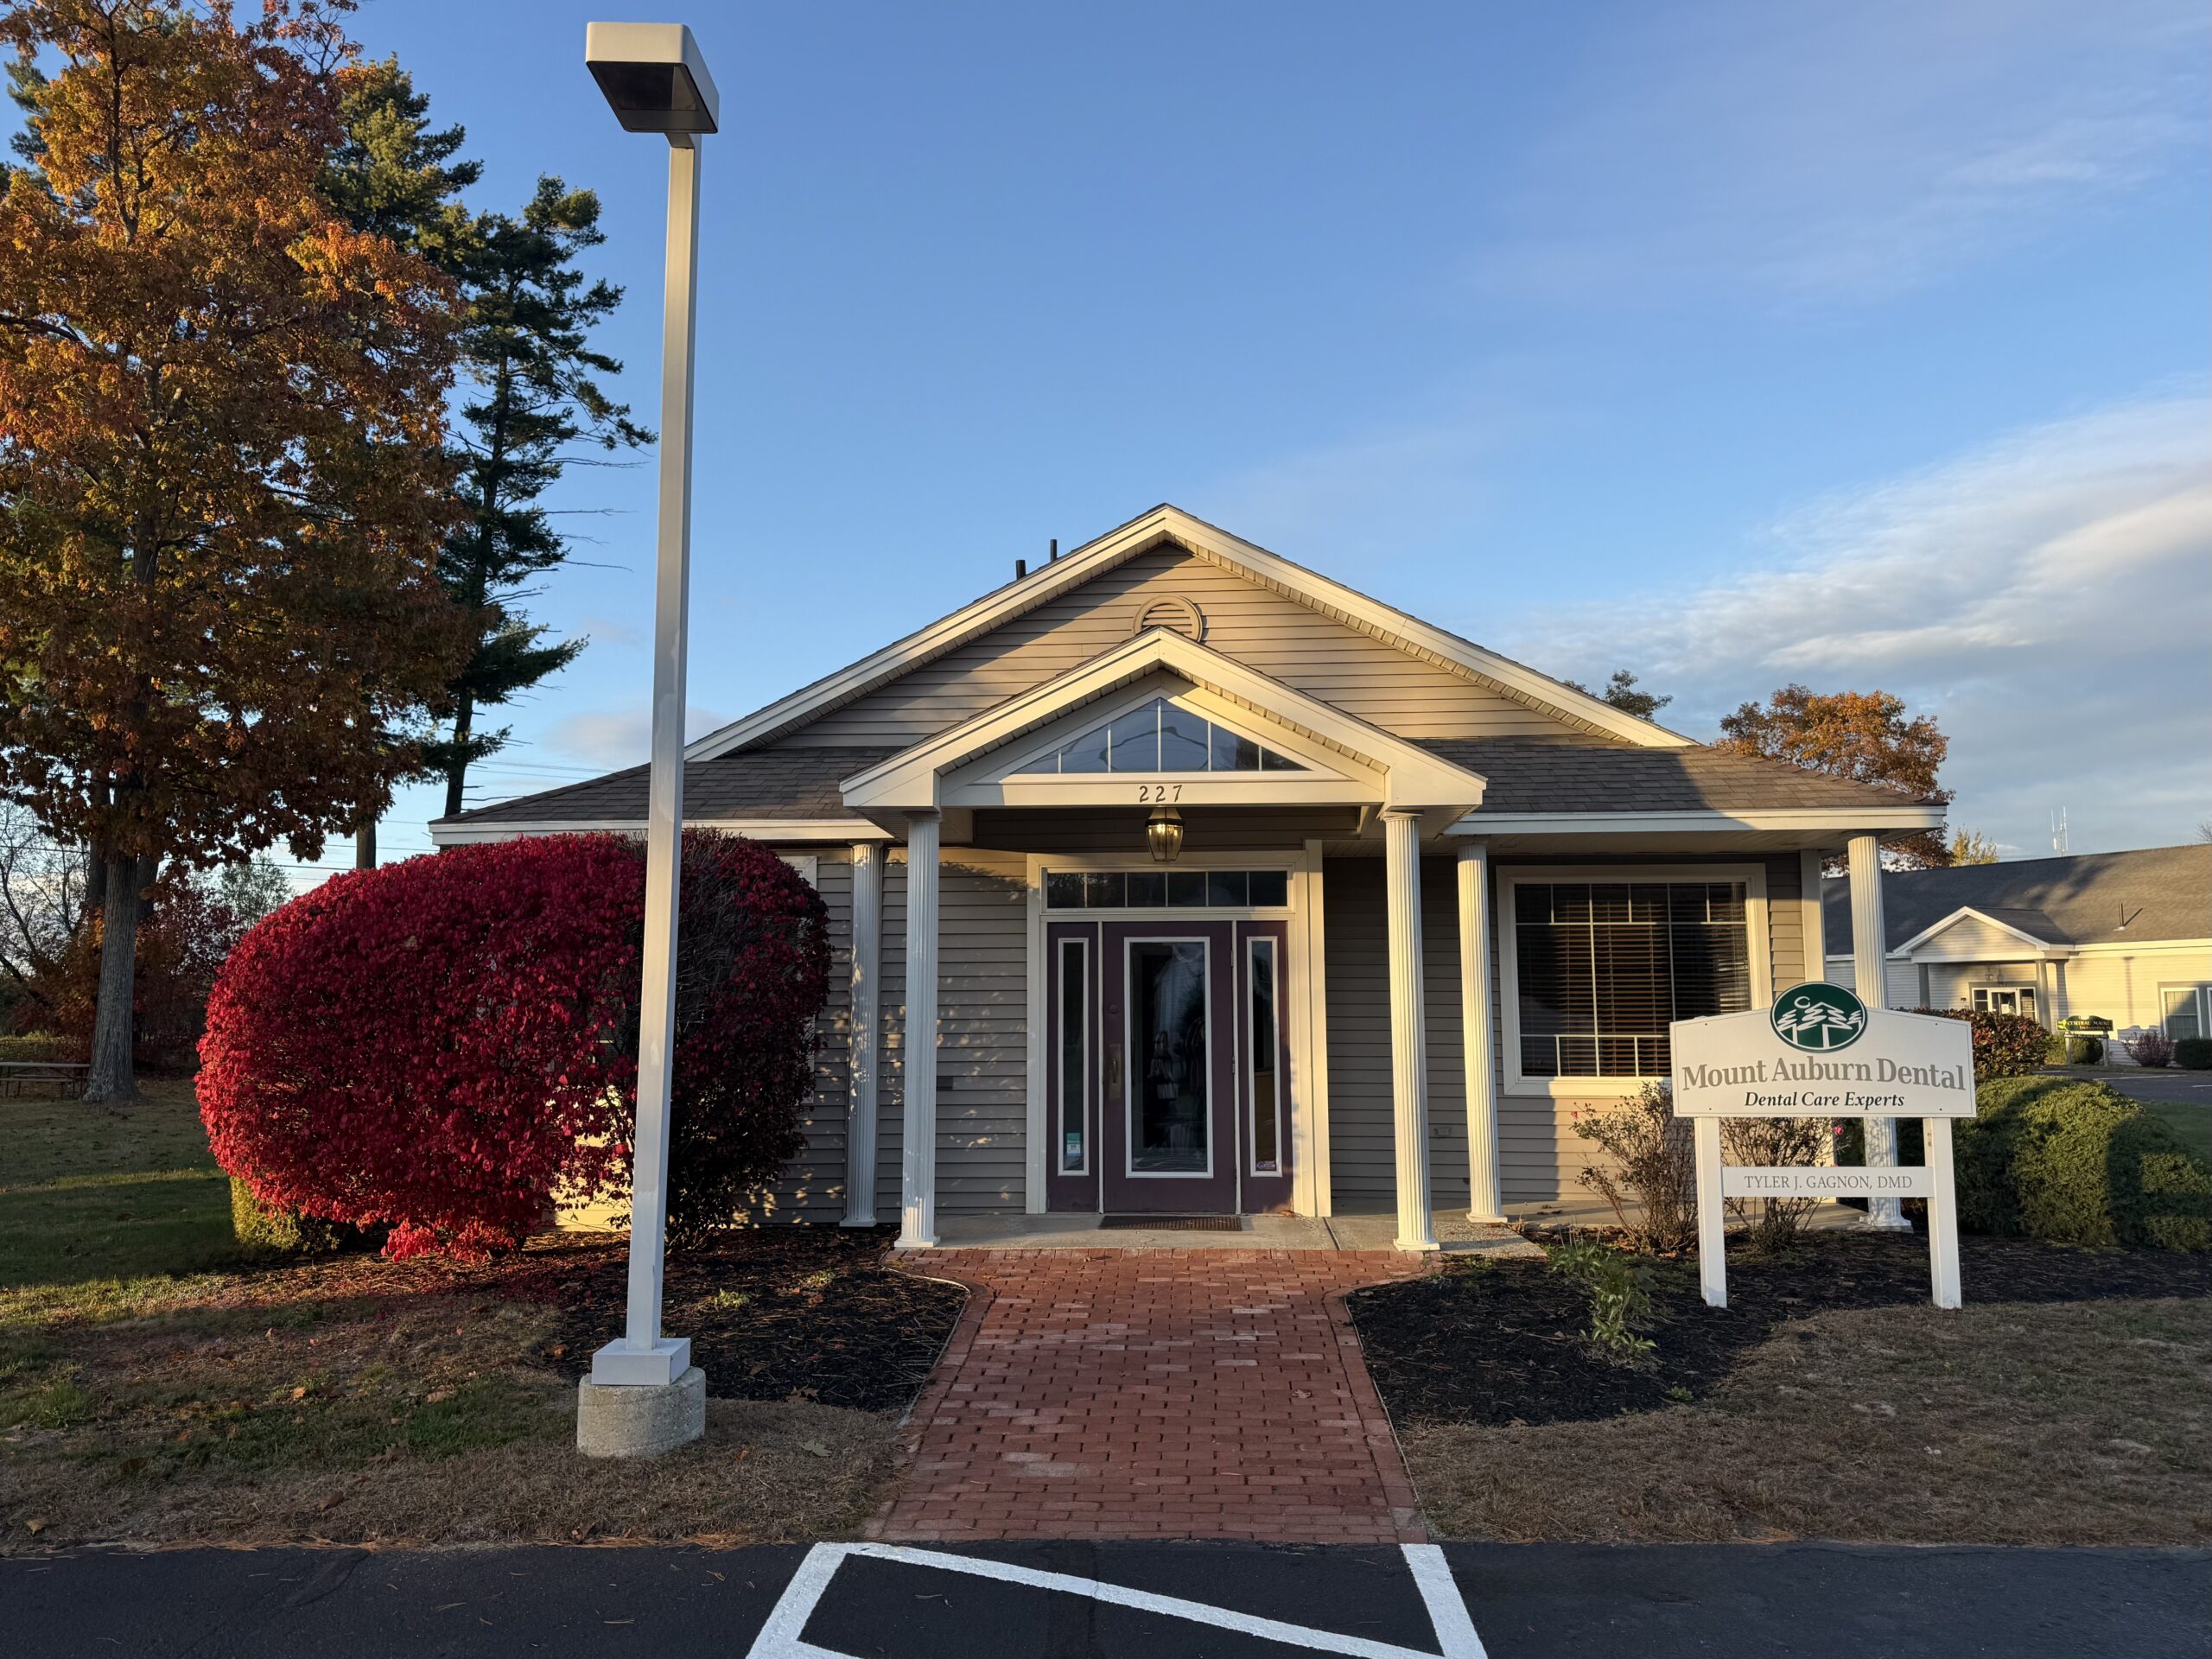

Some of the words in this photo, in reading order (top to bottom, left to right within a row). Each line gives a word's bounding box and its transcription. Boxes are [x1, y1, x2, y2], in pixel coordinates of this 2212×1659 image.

[1139, 785, 1183, 803] 227
[1681, 1059, 1768, 1090] Mount
[1771, 1056, 1872, 1082] Auburn
[1876, 1058, 1967, 1091] Dental
[1745, 1091, 1797, 1107] Dental
[1802, 1091, 1840, 1107] Care
[1844, 1091, 1905, 1110] Experts
[1744, 1175, 1789, 1188] TYLER
[1794, 1175, 1802, 1191] J.
[1806, 1175, 1872, 1190] GAGNON,
[1877, 1175, 1913, 1188] DMD
